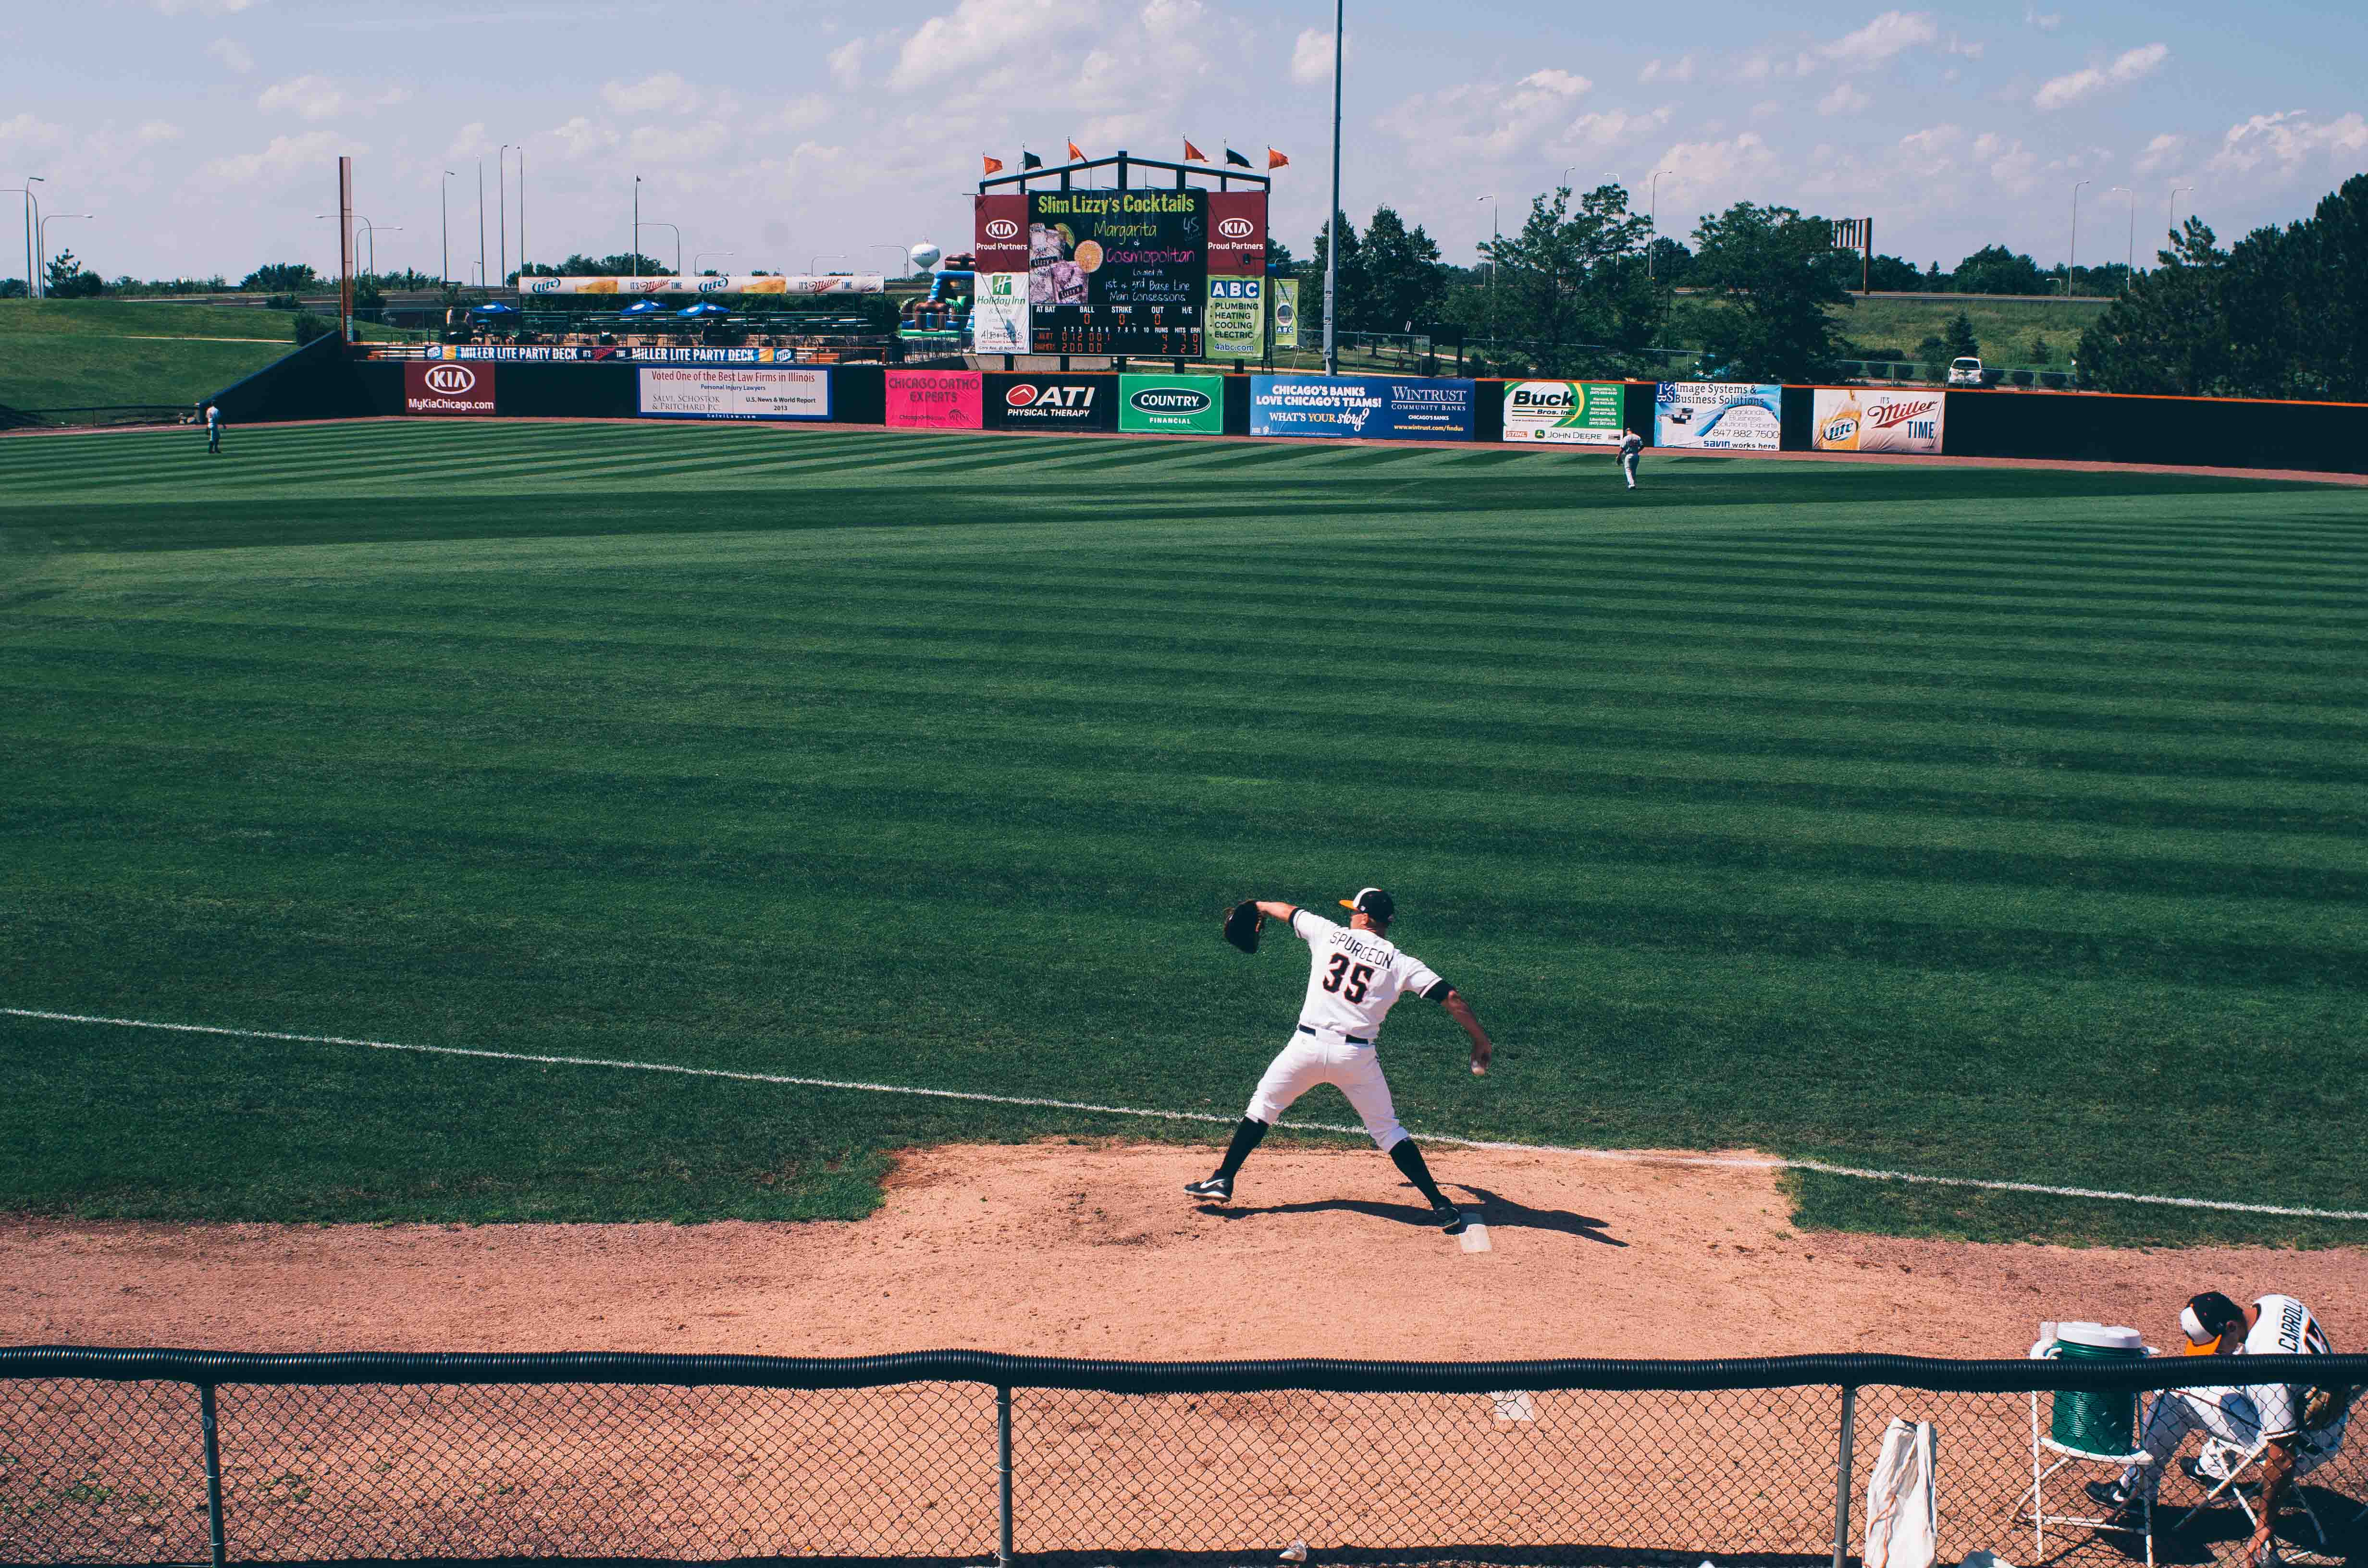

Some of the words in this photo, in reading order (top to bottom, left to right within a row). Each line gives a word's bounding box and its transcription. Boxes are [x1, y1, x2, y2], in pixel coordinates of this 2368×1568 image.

[1038, 196, 1069, 213] Slim
[1072, 195, 1120, 214] Lizzy's
[1124, 194, 1195, 212] Cocktails
[991, 223, 1012, 235] KIA
[1094, 220, 1157, 245] Margarita
[1224, 222, 1247, 234] KIA
[1232, 242, 1264, 250] Partners
[1107, 246, 1195, 267] Cosmopolitan
[799, 281, 808, 290] IT'S
[809, 279, 840, 292] Miller
[842, 281, 853, 290] TIME
[1149, 280, 1169, 291] Base
[1212, 282, 1258, 297] ABC
[977, 296, 1011, 306] Holiday
[1012, 296, 1025, 305] Inn
[1084, 313, 1090, 324] 0
[1119, 314, 1125, 325] 0
[1155, 314, 1160, 325] 0
[461, 347, 494, 359] MILLER
[497, 347, 517, 359] LITE
[519, 347, 550, 360] PARTY
[553, 348, 578, 360] DECK
[1215, 343, 1254, 351] 4abc.com
[632, 348, 667, 360] MILLER
[670, 348, 691, 361] LITE
[693, 349, 725, 361] PARTY
[728, 349, 754, 361] DECK
[433, 371, 467, 388] KIA
[652, 370, 674, 380] Voted
[676, 370, 691, 380] One
[693, 371, 702, 380] of
[703, 371, 716, 381] the
[718, 372, 735, 381] Best
[738, 372, 753, 382] Law
[755, 372, 777, 382] Firms
[779, 372, 785, 382] in
[788, 372, 815, 382] Illinois
[888, 377, 937, 389] CHICAGO
[938, 378, 979, 390] ORTHO
[1676, 384, 1705, 396] Image
[1708, 384, 1747, 396] Systems
[1750, 385, 1757, 394] &
[1035, 387, 1095, 407] ATI
[1272, 385, 1328, 396] CHICAGO'S
[1330, 387, 1365, 397] BANKS
[1392, 386, 1467, 401] WINTRUST
[408, 398, 494, 411] MyKiaChicago.com
[1256, 395, 1283, 405] LOVE
[1284, 396, 1341, 407] CHICAGO'S
[1342, 397, 1382, 407] TEAMS!
[1513, 390, 1577, 406] Buck
[1675, 394, 1716, 404] Business
[1718, 395, 1765, 406] Solutions
[1007, 408, 1048, 417] PHYSICAL
[1050, 409, 1090, 417] THERAPY
[1269, 412, 1306, 422] WHAT'S
[1308, 413, 1336, 423] YOUR
[1337, 407, 1370, 431] story?
[1867, 401, 1938, 426] Miller
[1547, 429, 1571, 439] JOHN
[1907, 420, 1935, 439] TIME
[1329, 931, 1394, 969] SPURGEON
[1322, 952, 1375, 1005] 35
[2278, 1298, 2303, 1353] CARROLL
